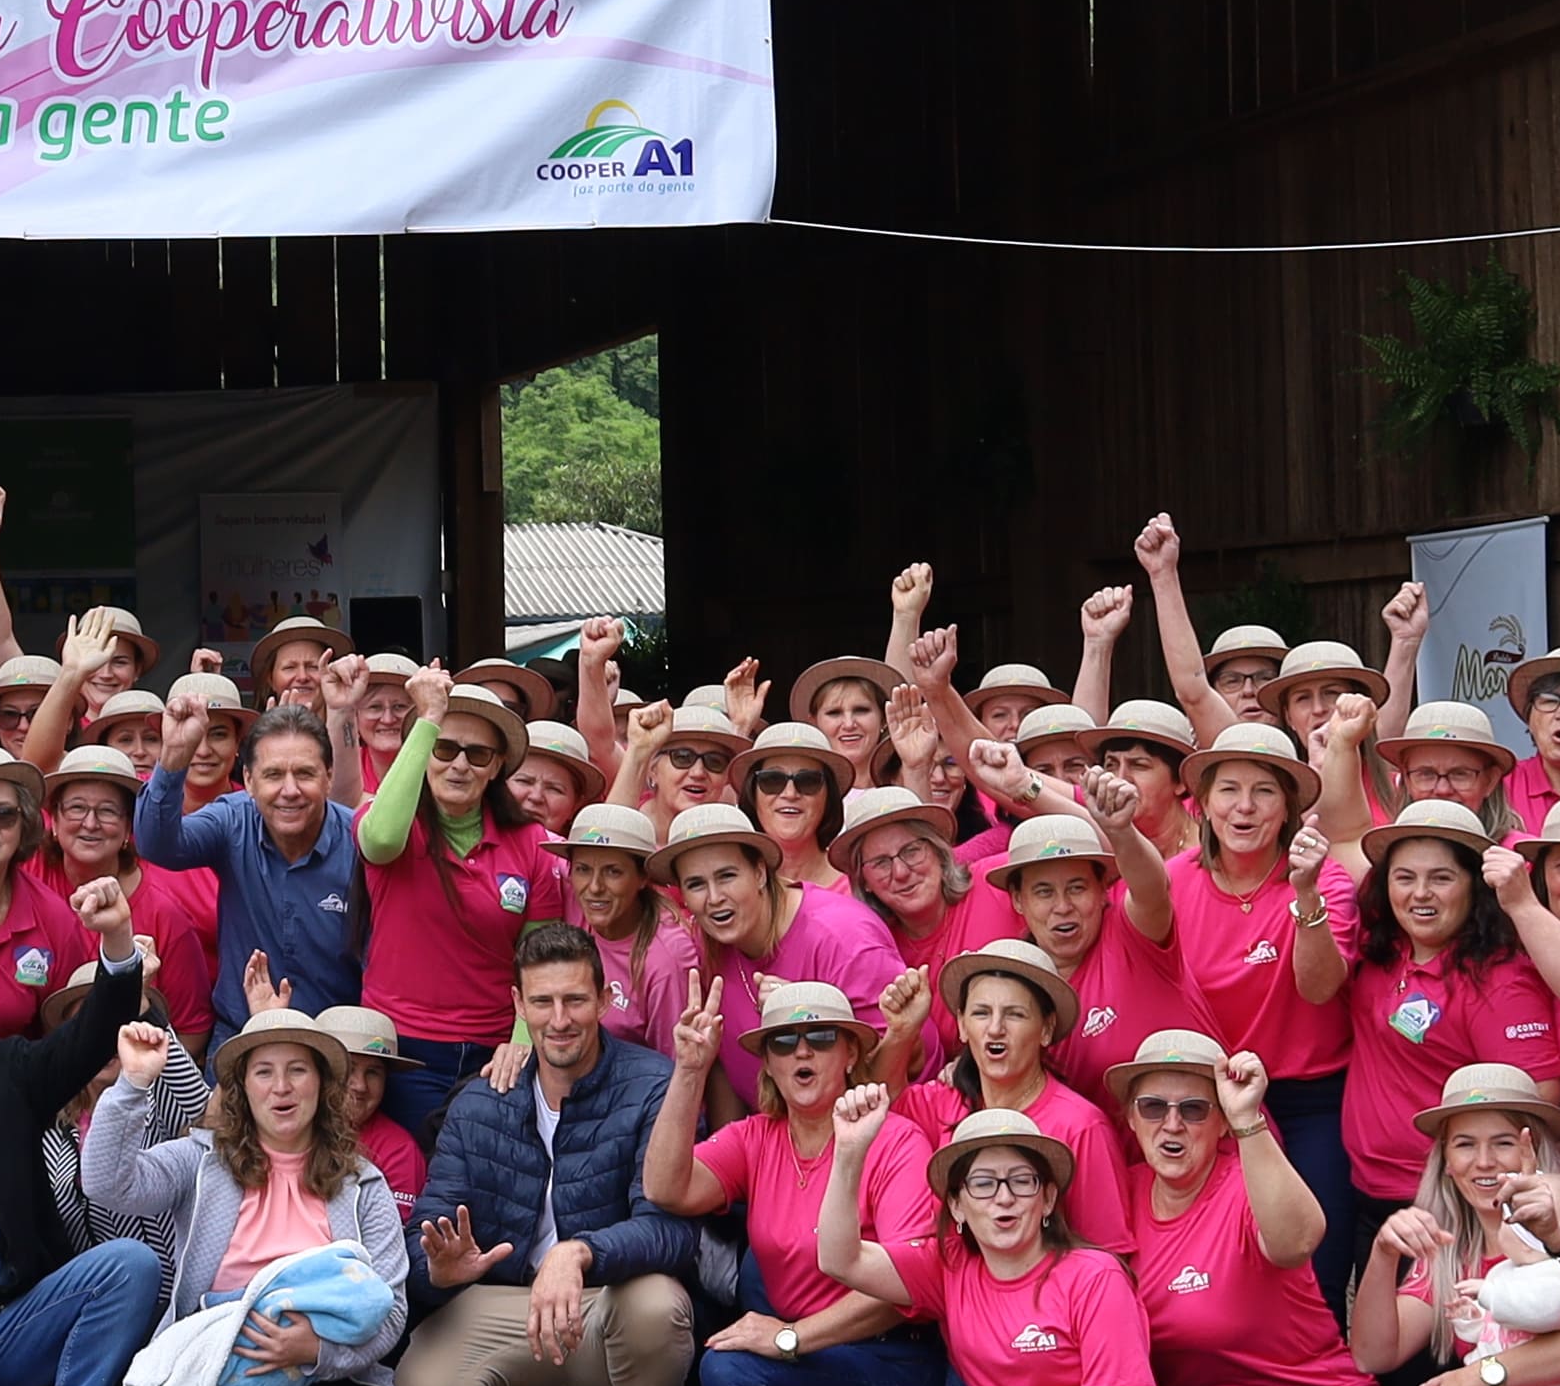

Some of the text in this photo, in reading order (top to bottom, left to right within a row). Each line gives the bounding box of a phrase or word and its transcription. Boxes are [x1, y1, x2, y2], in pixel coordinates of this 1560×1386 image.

[38, 90, 229, 160] gente
[536, 138, 695, 181] COOPER A1
[573, 180, 695, 197] faz parte da gente
[1193, 1273, 1209, 1286] A1
[1037, 1333, 1057, 1346] A1
